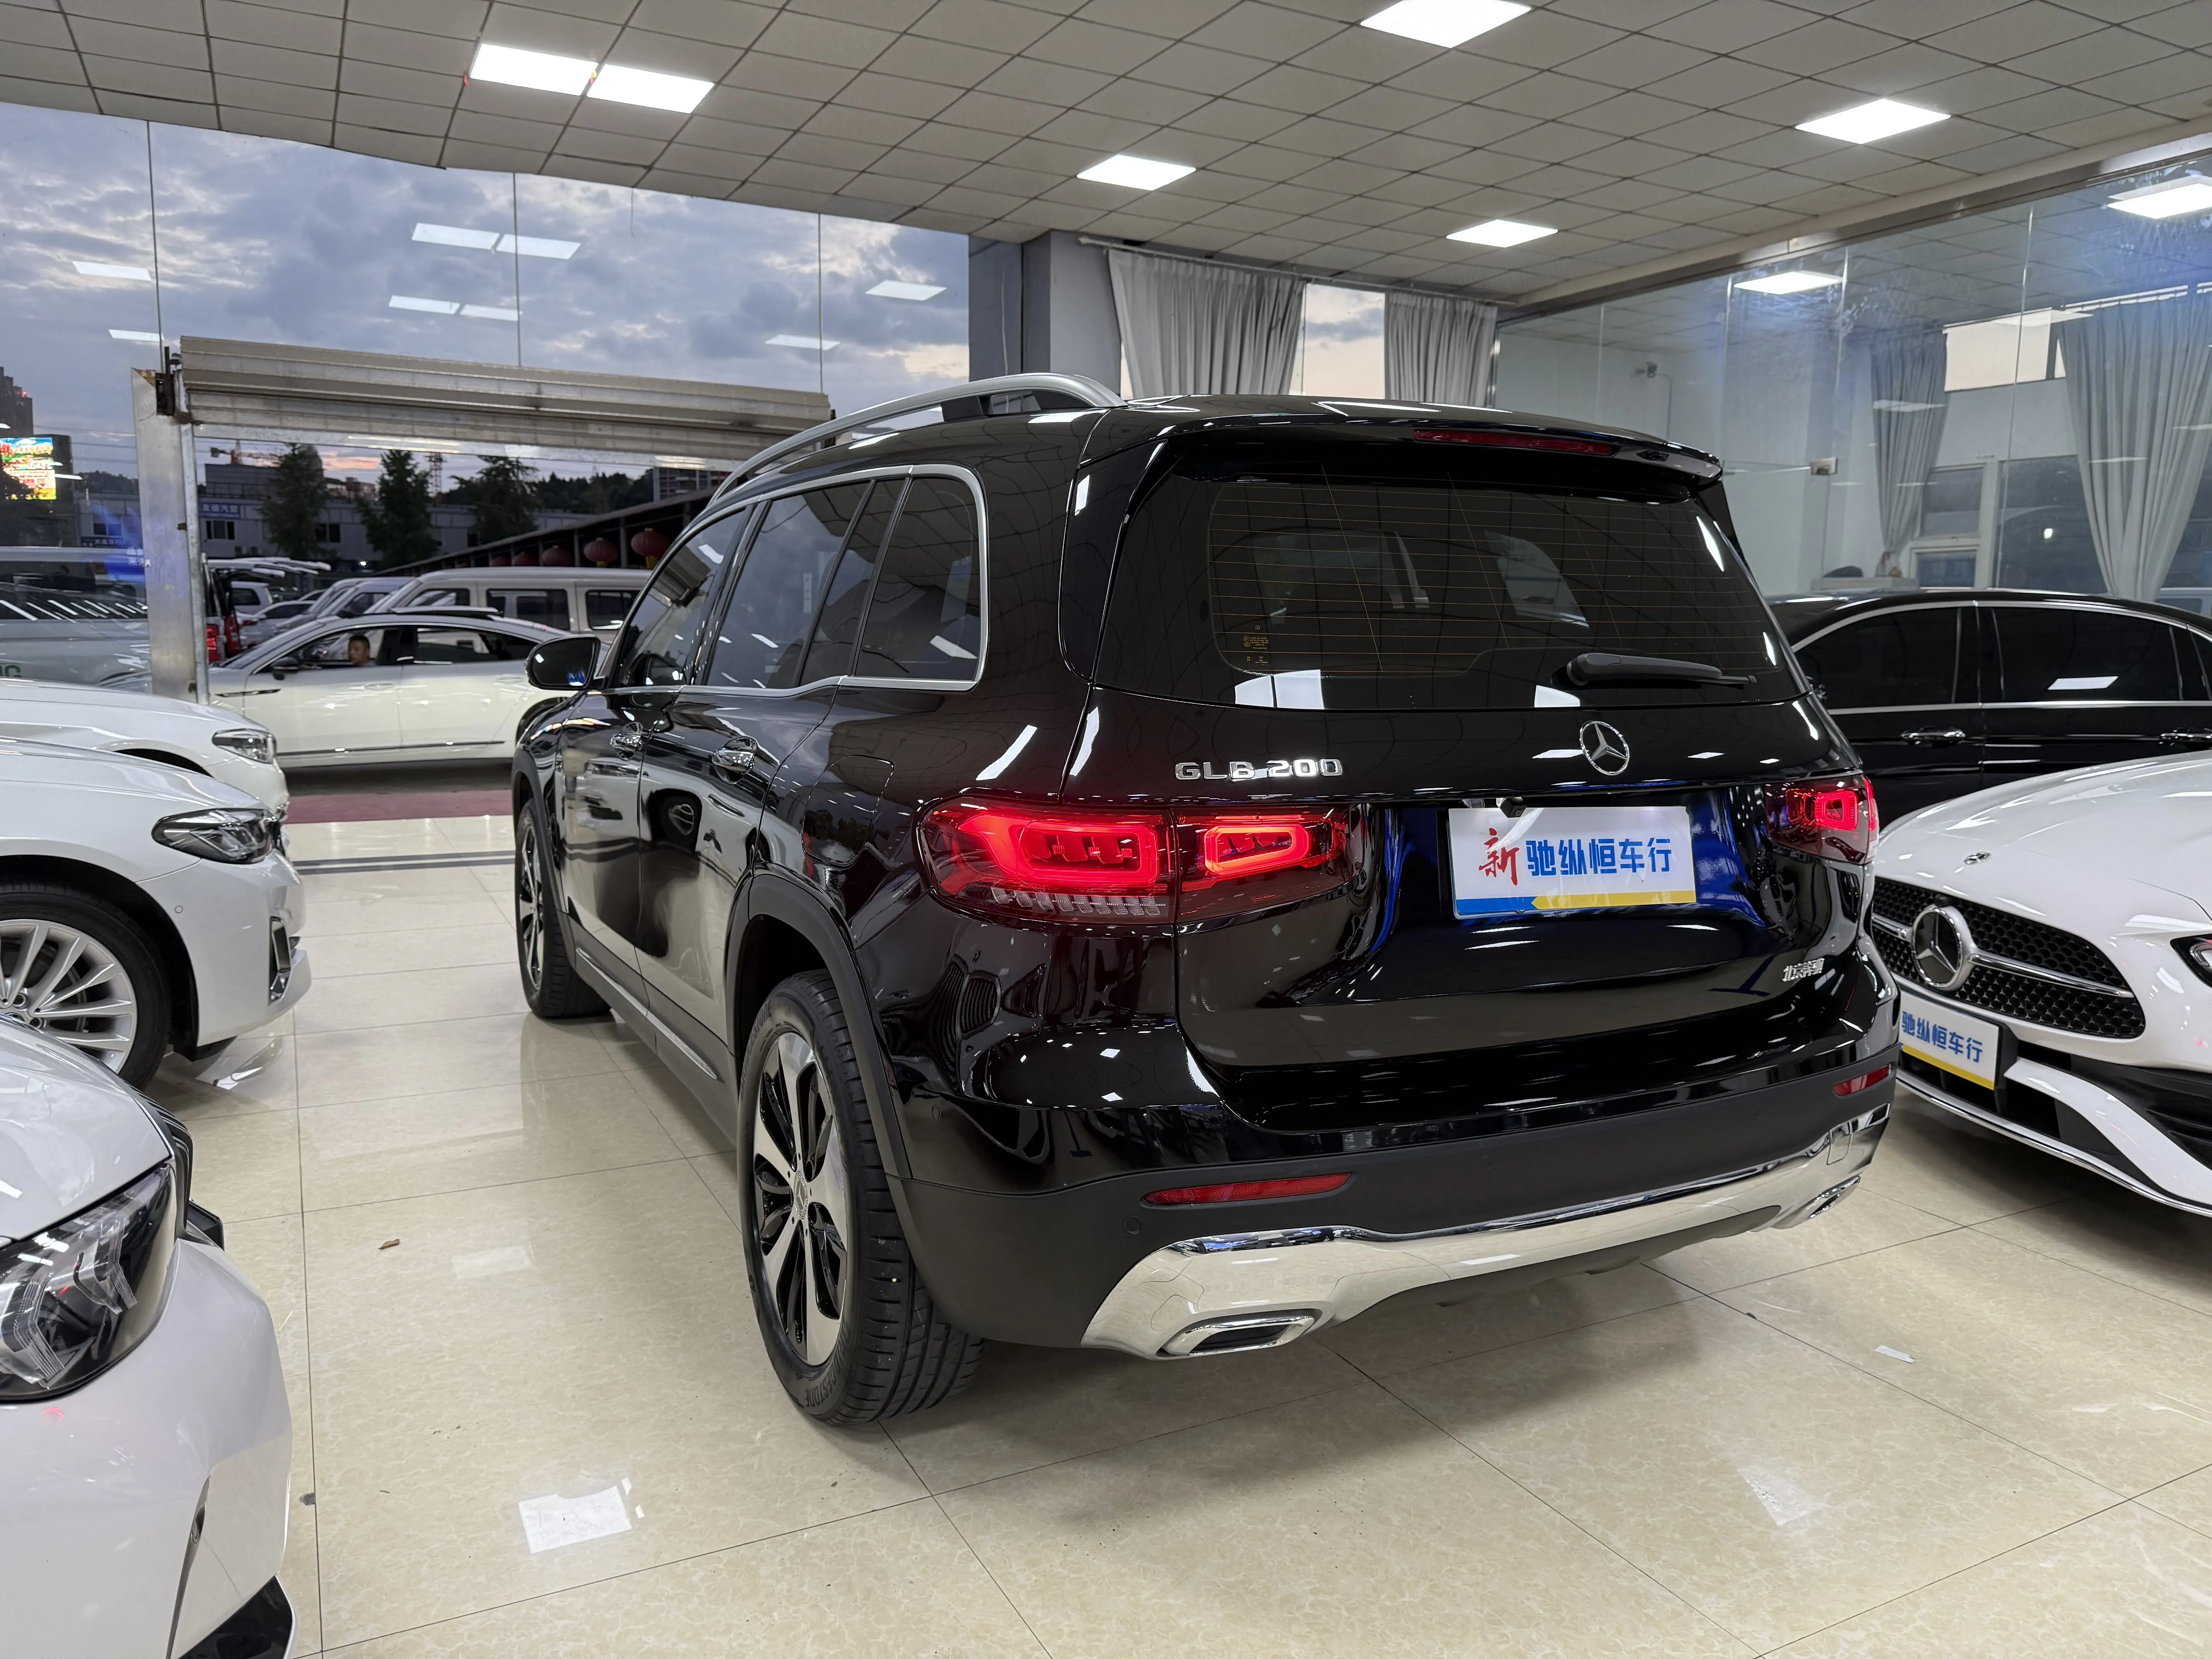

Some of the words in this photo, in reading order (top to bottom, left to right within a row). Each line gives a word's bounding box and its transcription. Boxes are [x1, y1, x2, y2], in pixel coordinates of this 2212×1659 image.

[1175, 761, 1255, 781] GLB
[1266, 759, 1343, 777] 200
[1902, 1011, 1983, 1063] 驰纵恒车行
